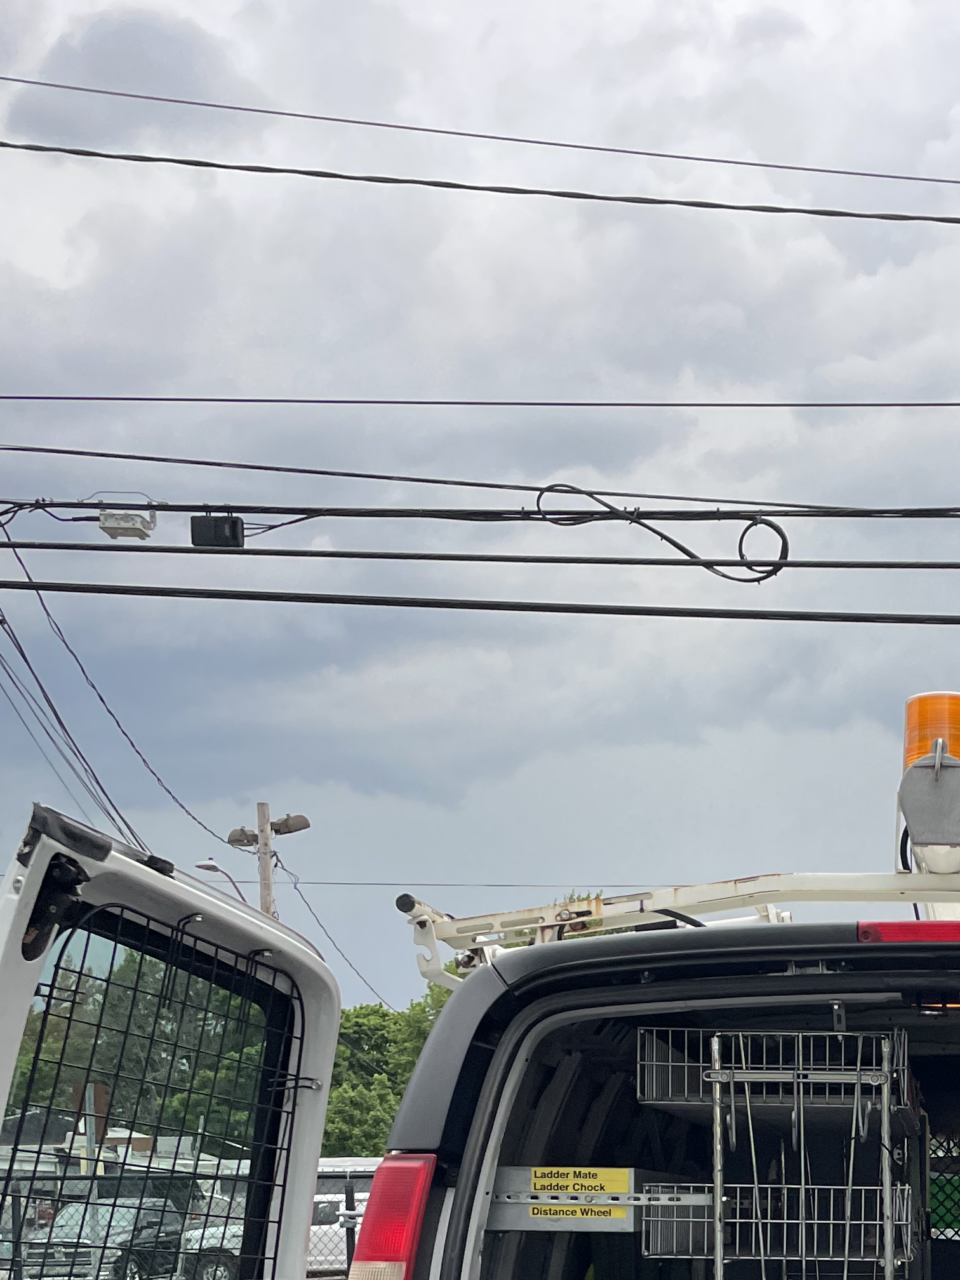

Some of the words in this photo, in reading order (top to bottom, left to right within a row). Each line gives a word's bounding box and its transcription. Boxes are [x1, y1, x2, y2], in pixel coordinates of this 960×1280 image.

[533, 1170, 570, 1179] Ladder
[573, 1171, 598, 1180] Mate
[533, 1182, 570, 1191] Ladder
[572, 1182, 606, 1192] Chock
[531, 1207, 578, 1216] Distance
[580, 1208, 612, 1217] Wheel
